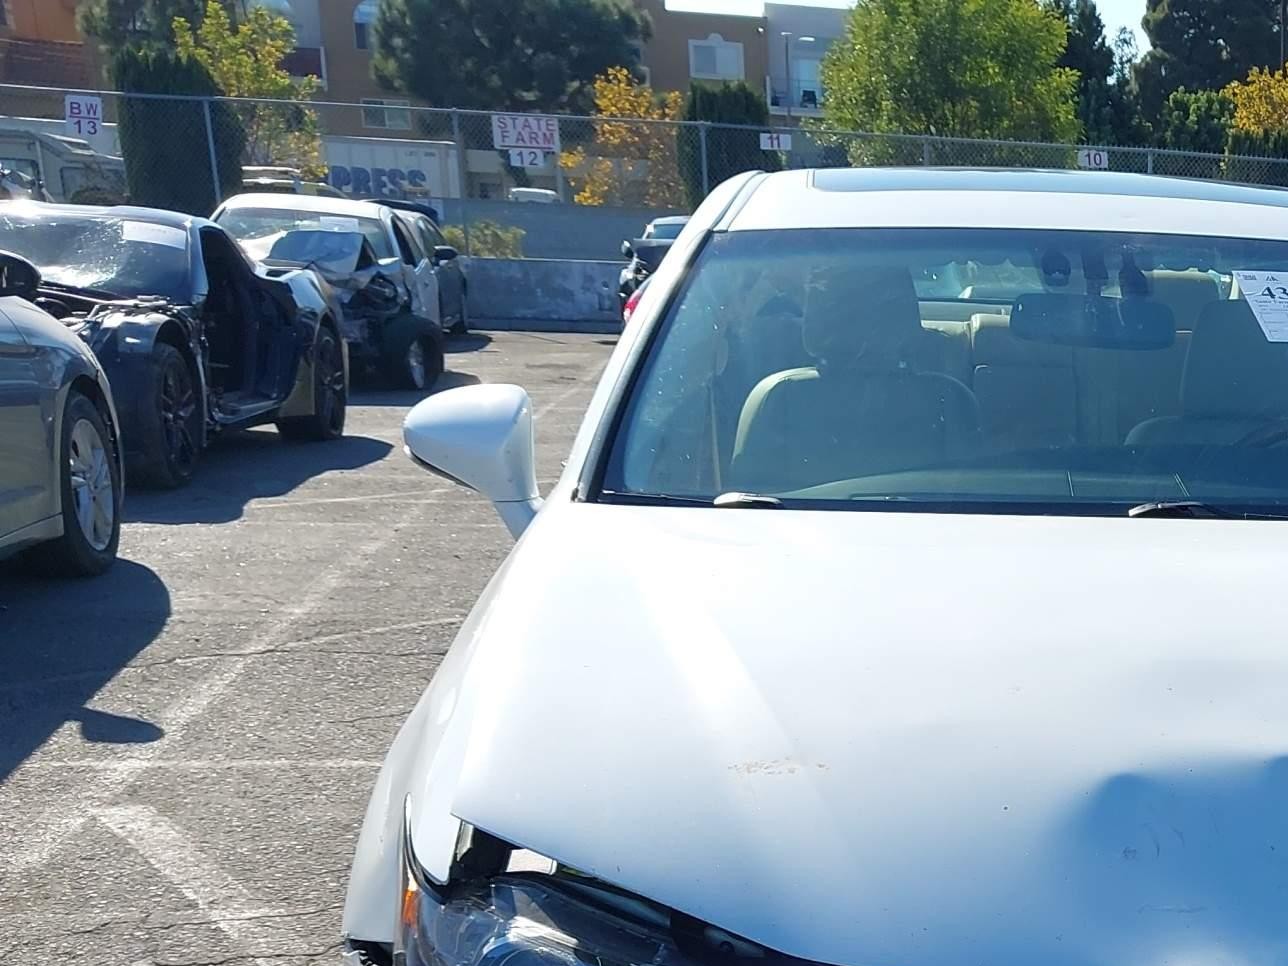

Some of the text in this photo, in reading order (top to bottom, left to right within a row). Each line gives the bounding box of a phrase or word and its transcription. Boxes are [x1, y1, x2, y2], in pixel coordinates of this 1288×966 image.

[70, 101, 98, 116] BW
[73, 120, 97, 135] 13
[497, 117, 556, 131] STATE
[500, 130, 555, 145] FARM
[768, 134, 781, 149] 11
[516, 151, 539, 166] 12
[1084, 152, 1102, 167] 10
